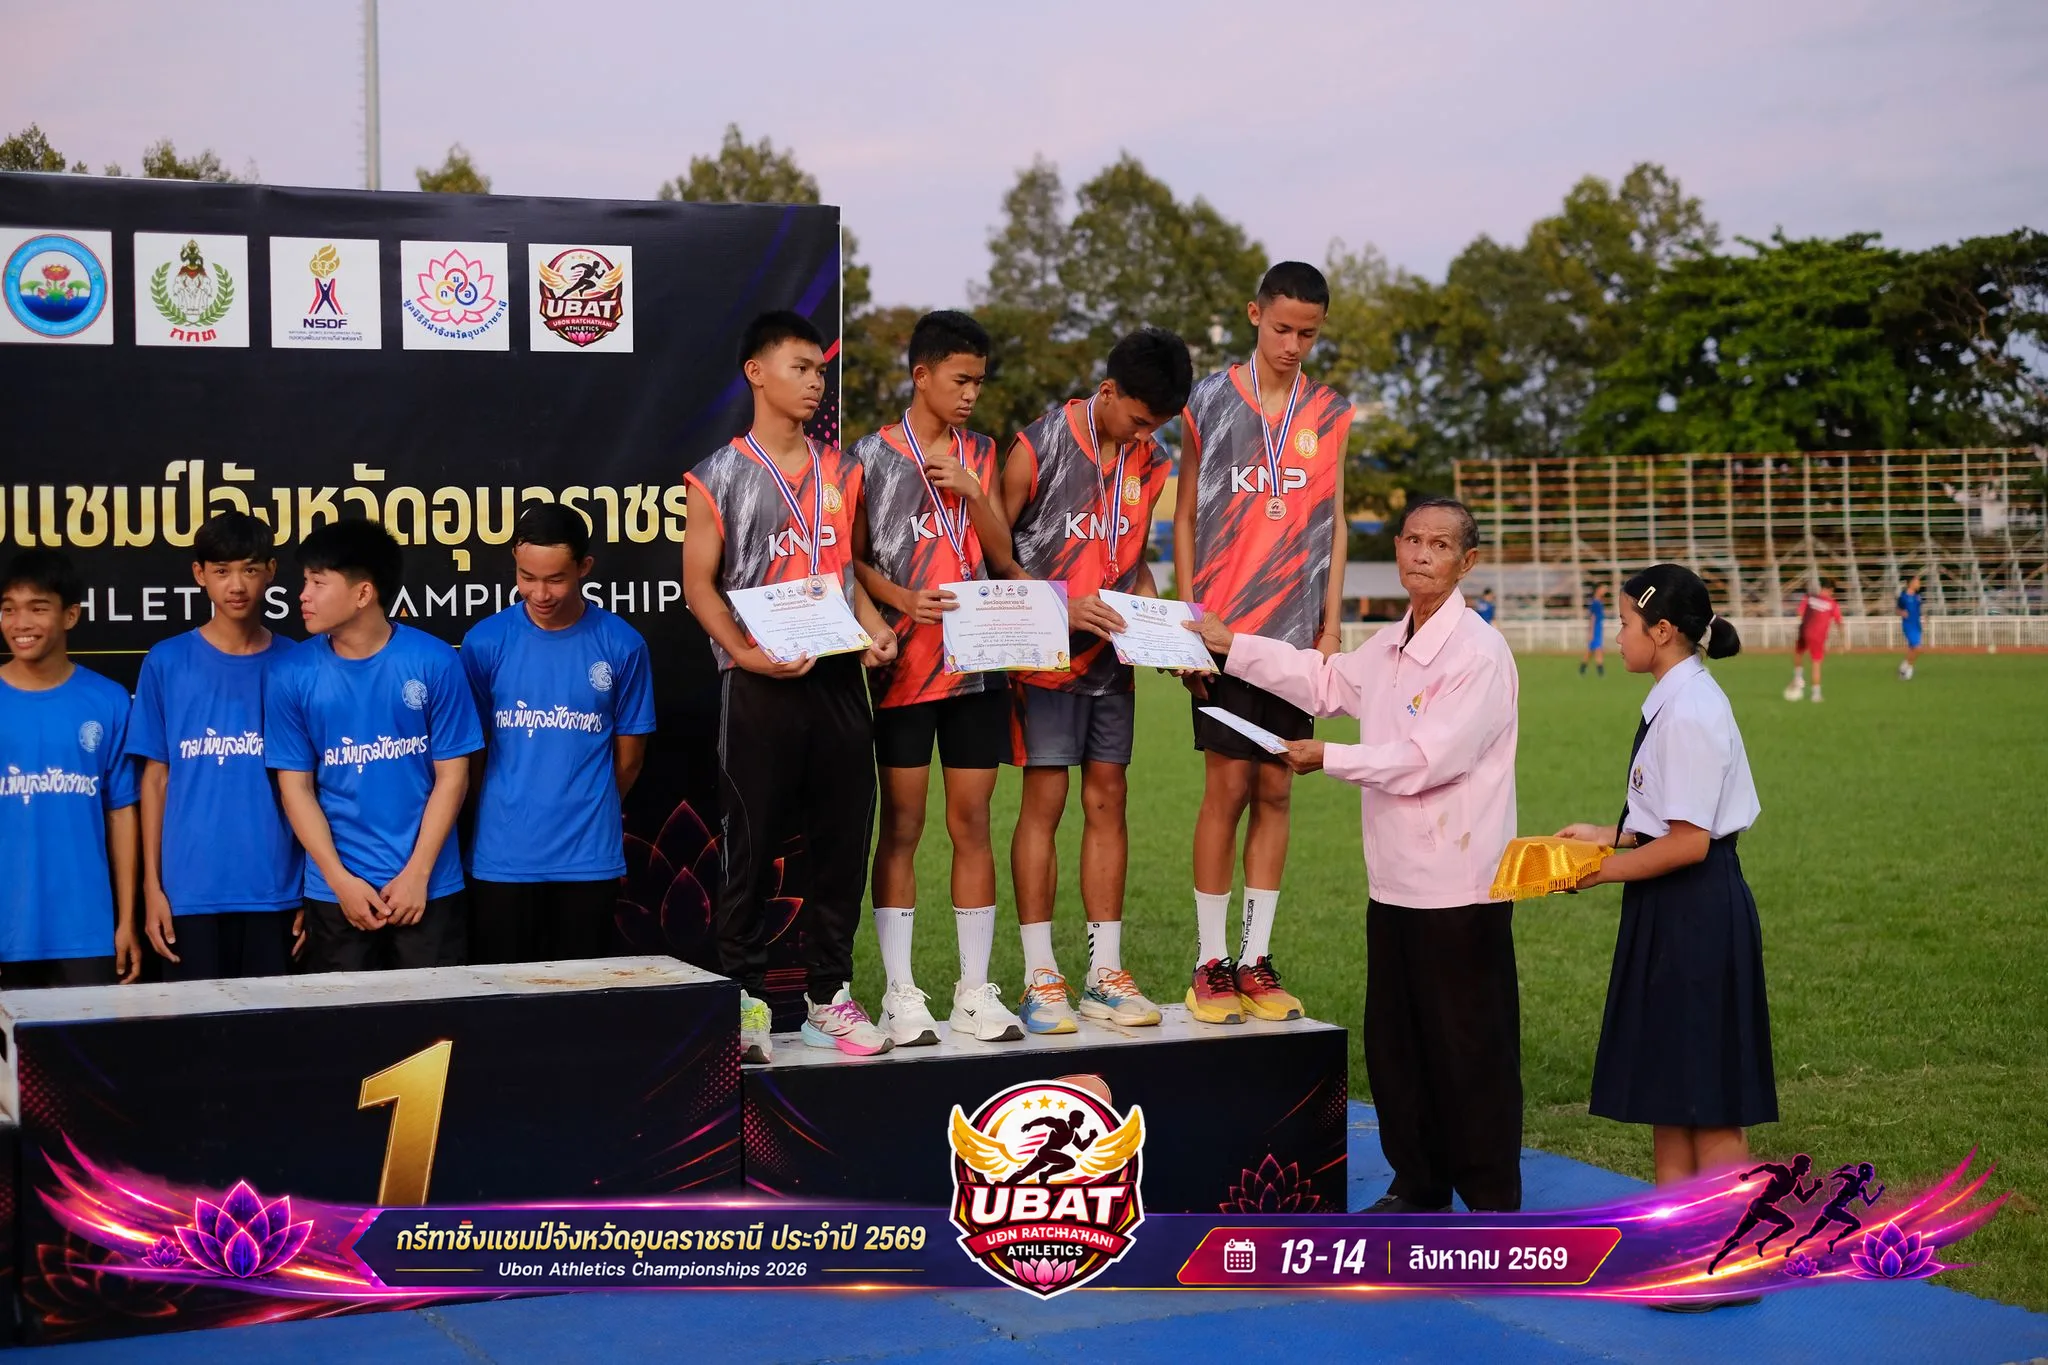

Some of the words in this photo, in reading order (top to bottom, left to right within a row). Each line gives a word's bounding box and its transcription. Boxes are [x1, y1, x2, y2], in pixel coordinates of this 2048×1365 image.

[546, 300, 617, 319] UBAT
[303, 318, 348, 329] NSDF
[552, 319, 571, 327] UBON
[170, 327, 217, 343] กกท
[1231, 465, 1307, 494] KNP
[358, 1040, 453, 1207] 1
